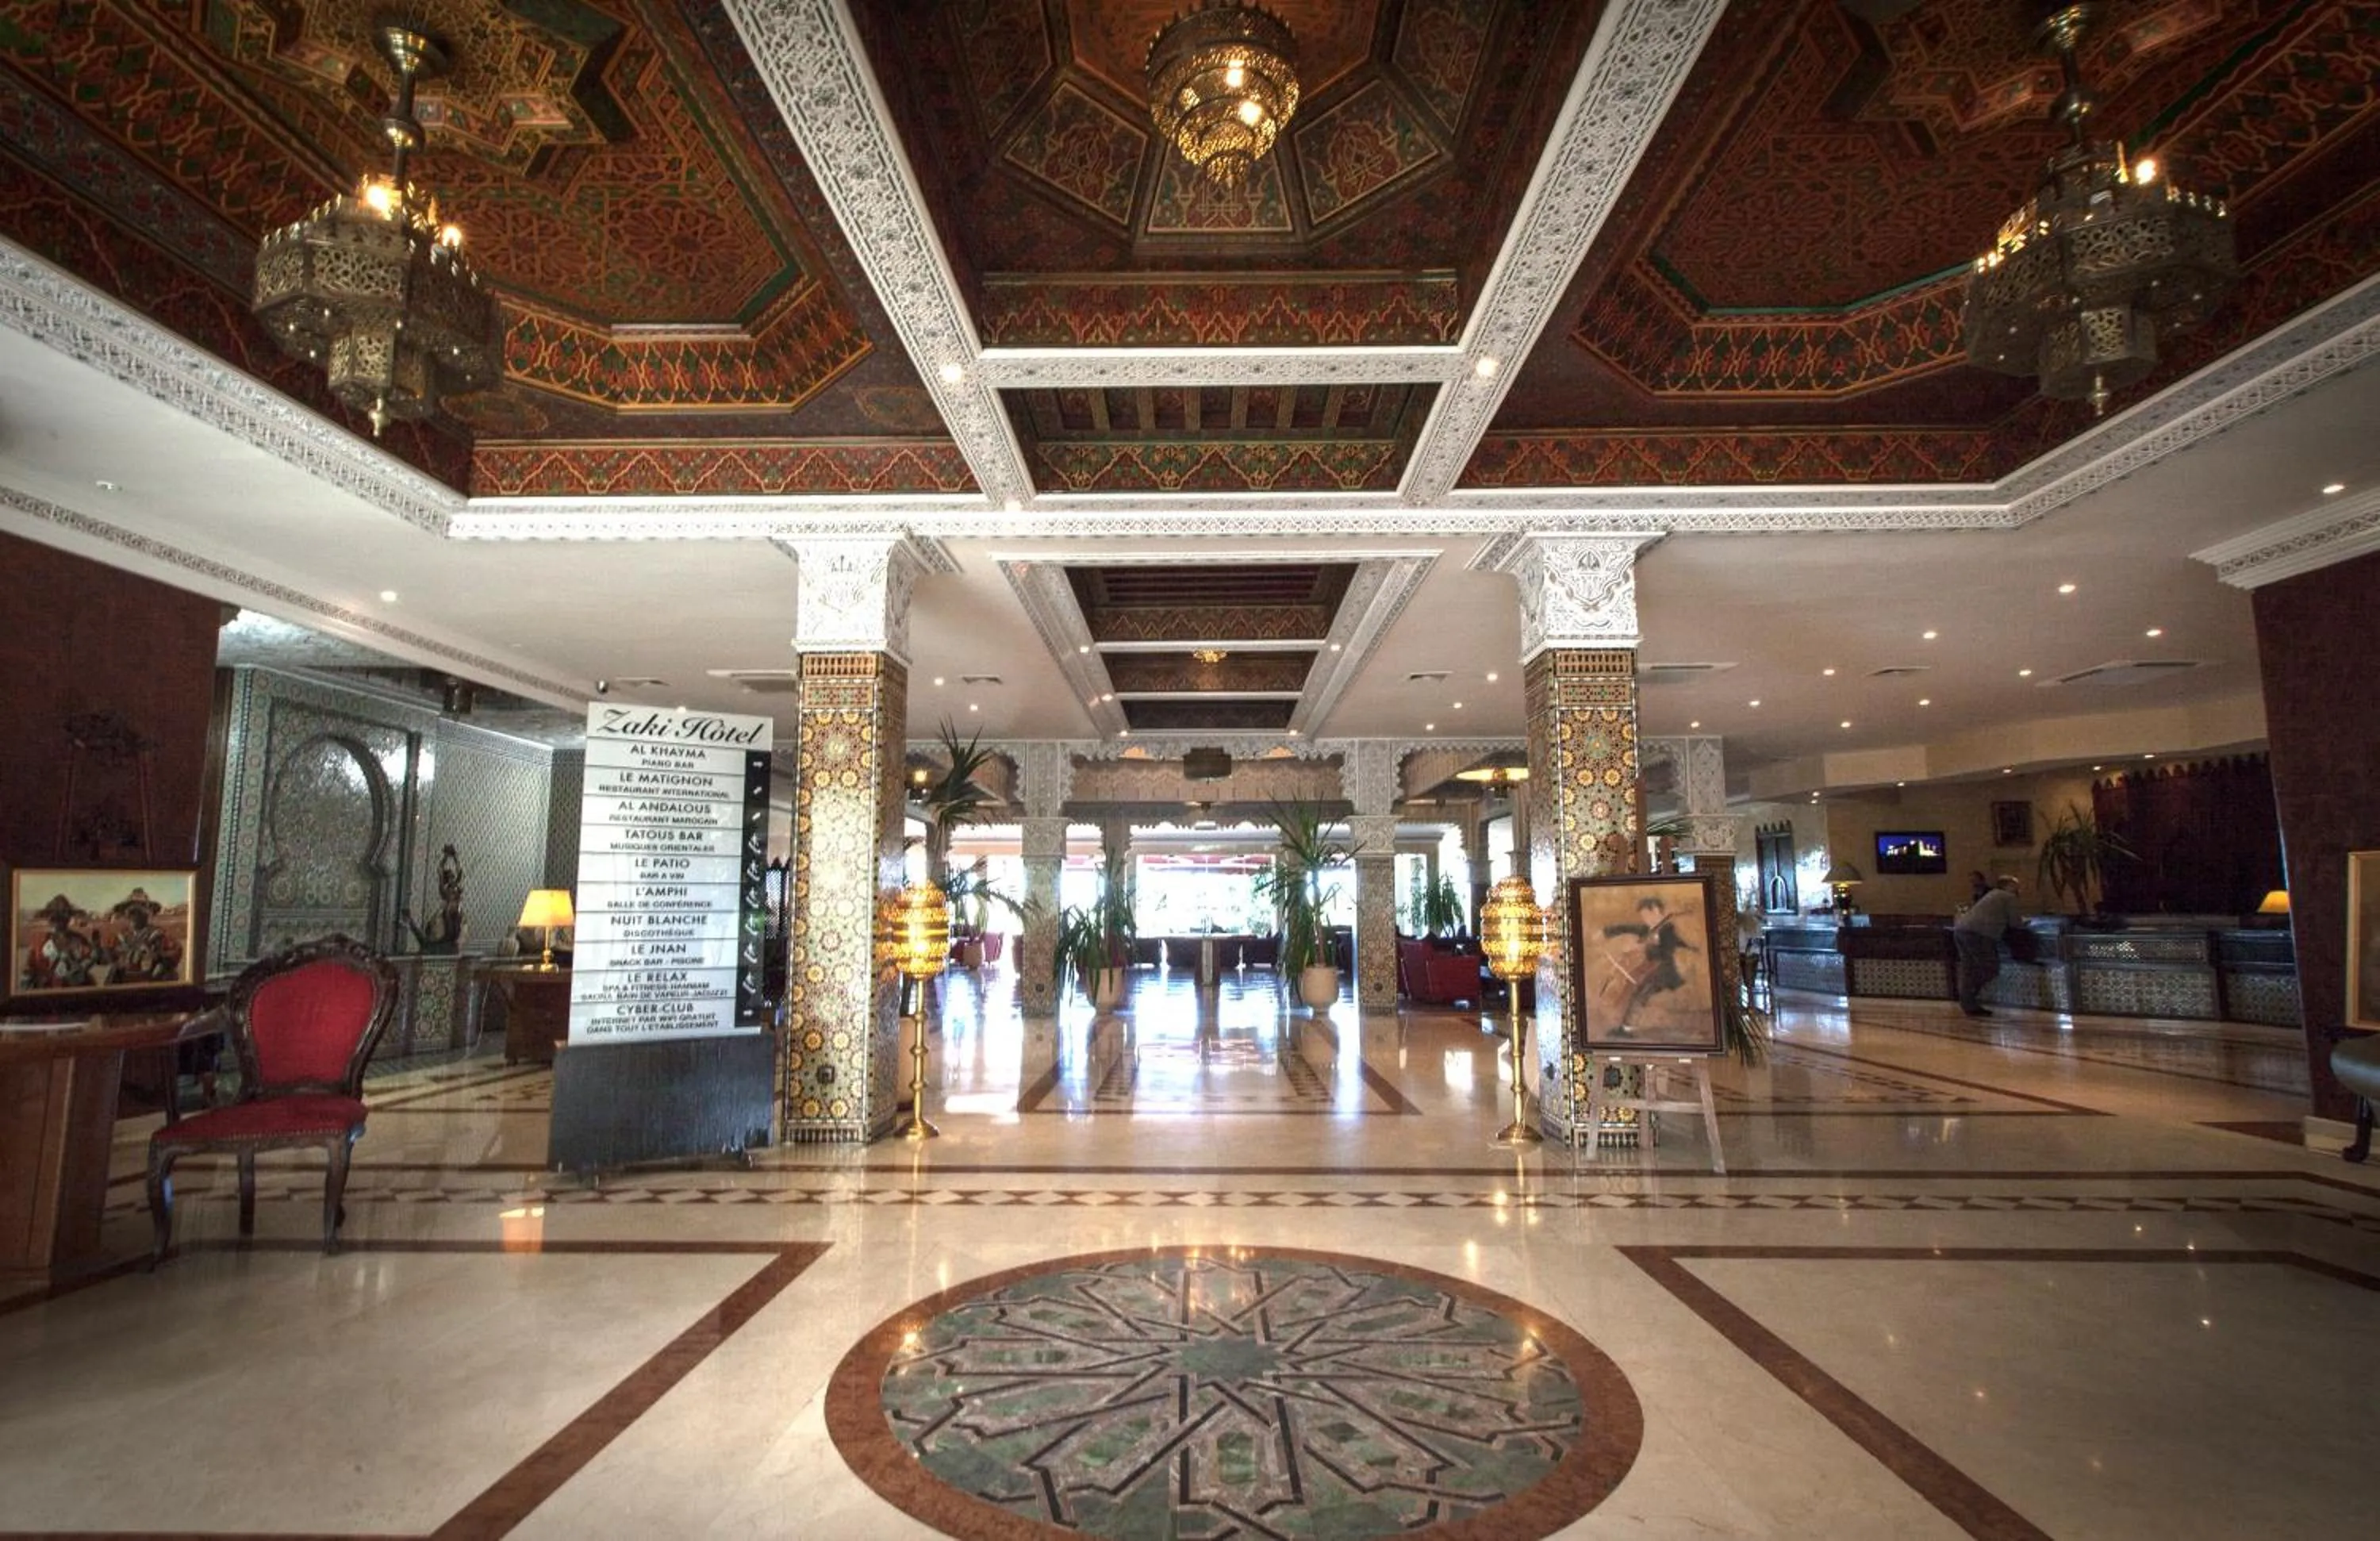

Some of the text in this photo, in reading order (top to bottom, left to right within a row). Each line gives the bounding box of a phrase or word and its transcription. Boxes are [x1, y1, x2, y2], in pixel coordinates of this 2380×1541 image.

[597, 709, 764, 744] Zaki Hôtel
[631, 744, 706, 759] AL KHAYMA
[642, 759, 694, 769] PIANO BAR
[620, 772, 713, 787] LE MATIGNON
[599, 784, 730, 799] RESTAURANT INTERNATIONAL
[618, 801, 712, 814] AL ANDALOUS
[609, 815, 718, 825] RESTAURANT MAROCAIN
[625, 829, 703, 841] TATOUS BAR
[610, 843, 715, 852] MUSIQUES ORIENTALES
[635, 857, 690, 869] LE PATIO
[635, 886, 688, 897] L'AMPHI
[610, 915, 708, 925] NUIT BLANCHE
[631, 943, 686, 955] LE JNAN
[609, 958, 641, 966] SNACK
[670, 956, 704, 965] PISCINE
[628, 971, 688, 982] LE RELAX
